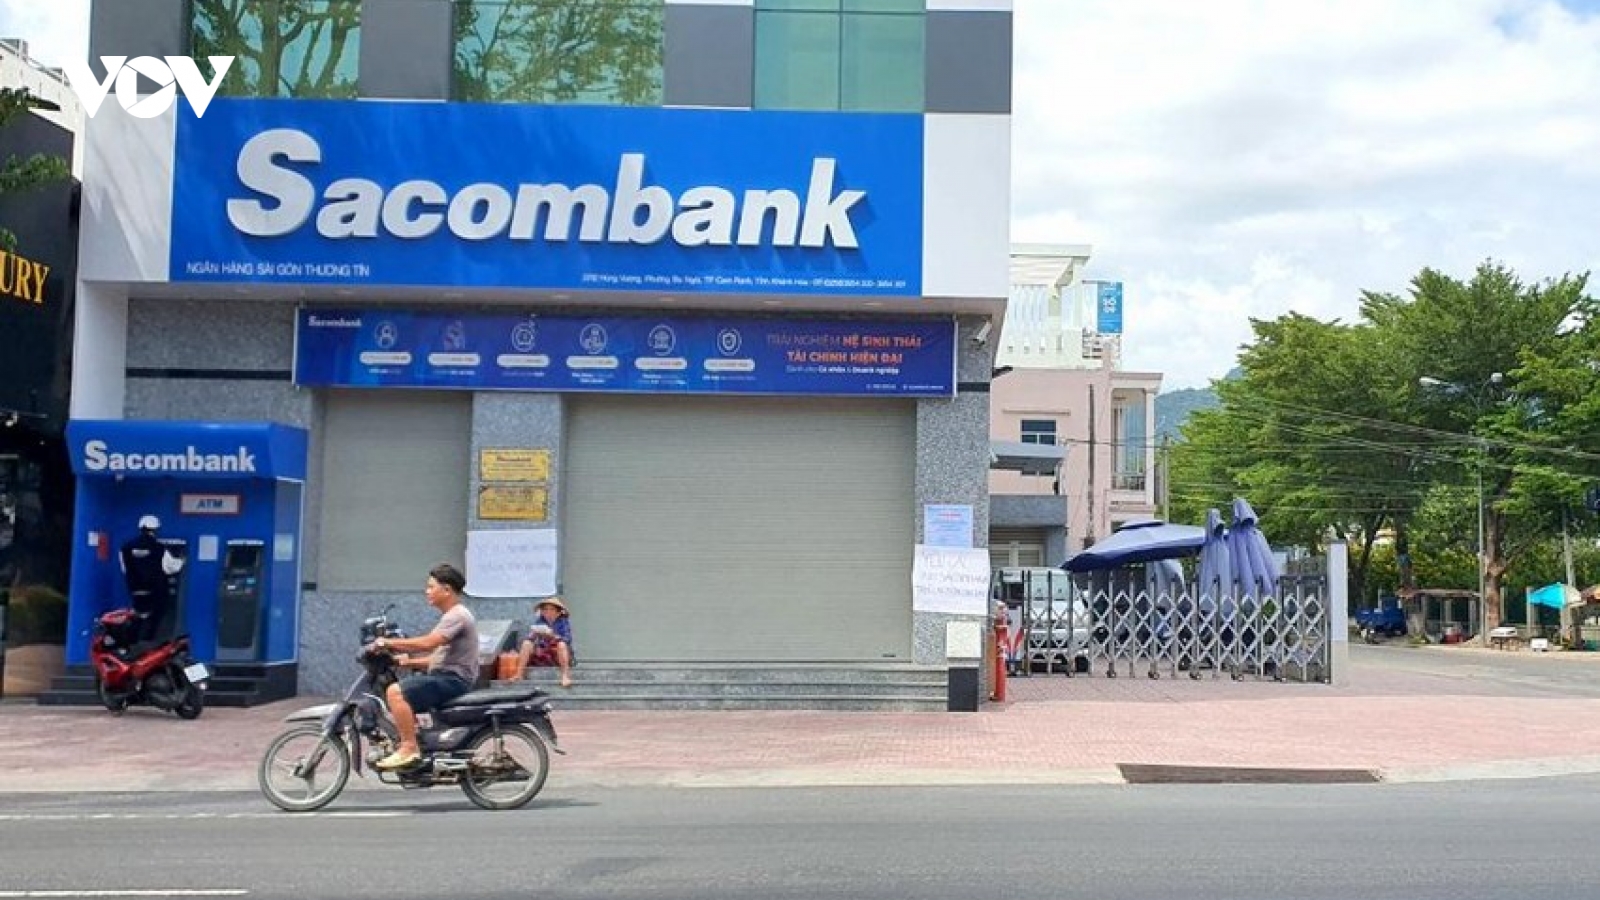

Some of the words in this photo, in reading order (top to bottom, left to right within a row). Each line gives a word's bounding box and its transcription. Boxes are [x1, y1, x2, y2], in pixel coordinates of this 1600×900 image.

[226, 128, 867, 249] Sacombank
[84, 440, 256, 474] Sacombank
[196, 498, 223, 508] ATM
